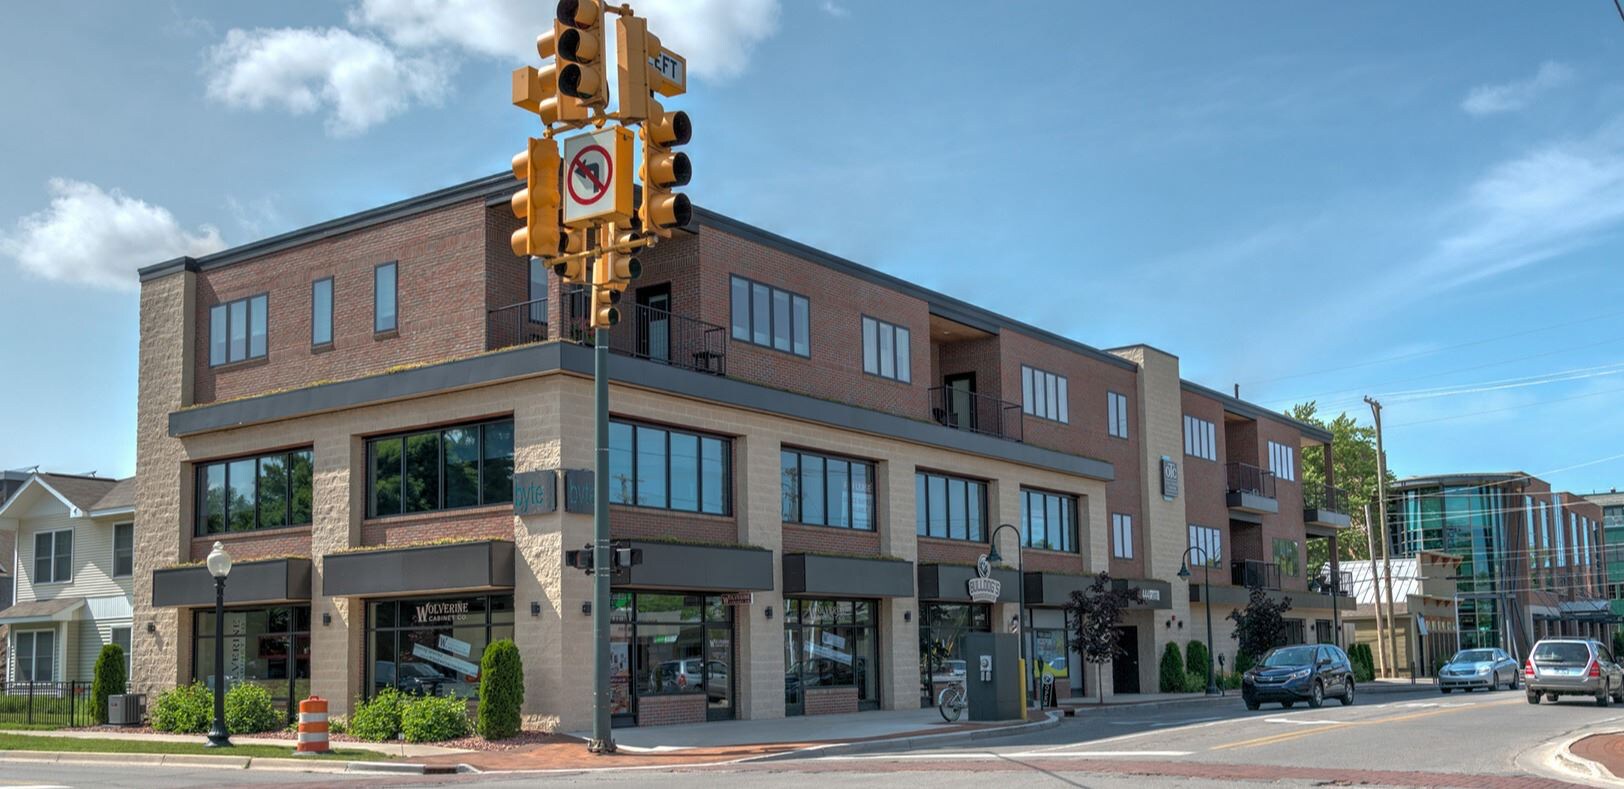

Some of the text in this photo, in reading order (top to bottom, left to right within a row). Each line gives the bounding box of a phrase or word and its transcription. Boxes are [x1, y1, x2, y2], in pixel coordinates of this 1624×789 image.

[648, 53, 677, 79] EFT
[515, 481, 544, 512] byte
[569, 479, 596, 508] byt
[416, 602, 469, 622] WOLVERINE
[231, 618, 240, 684] LVERINE
